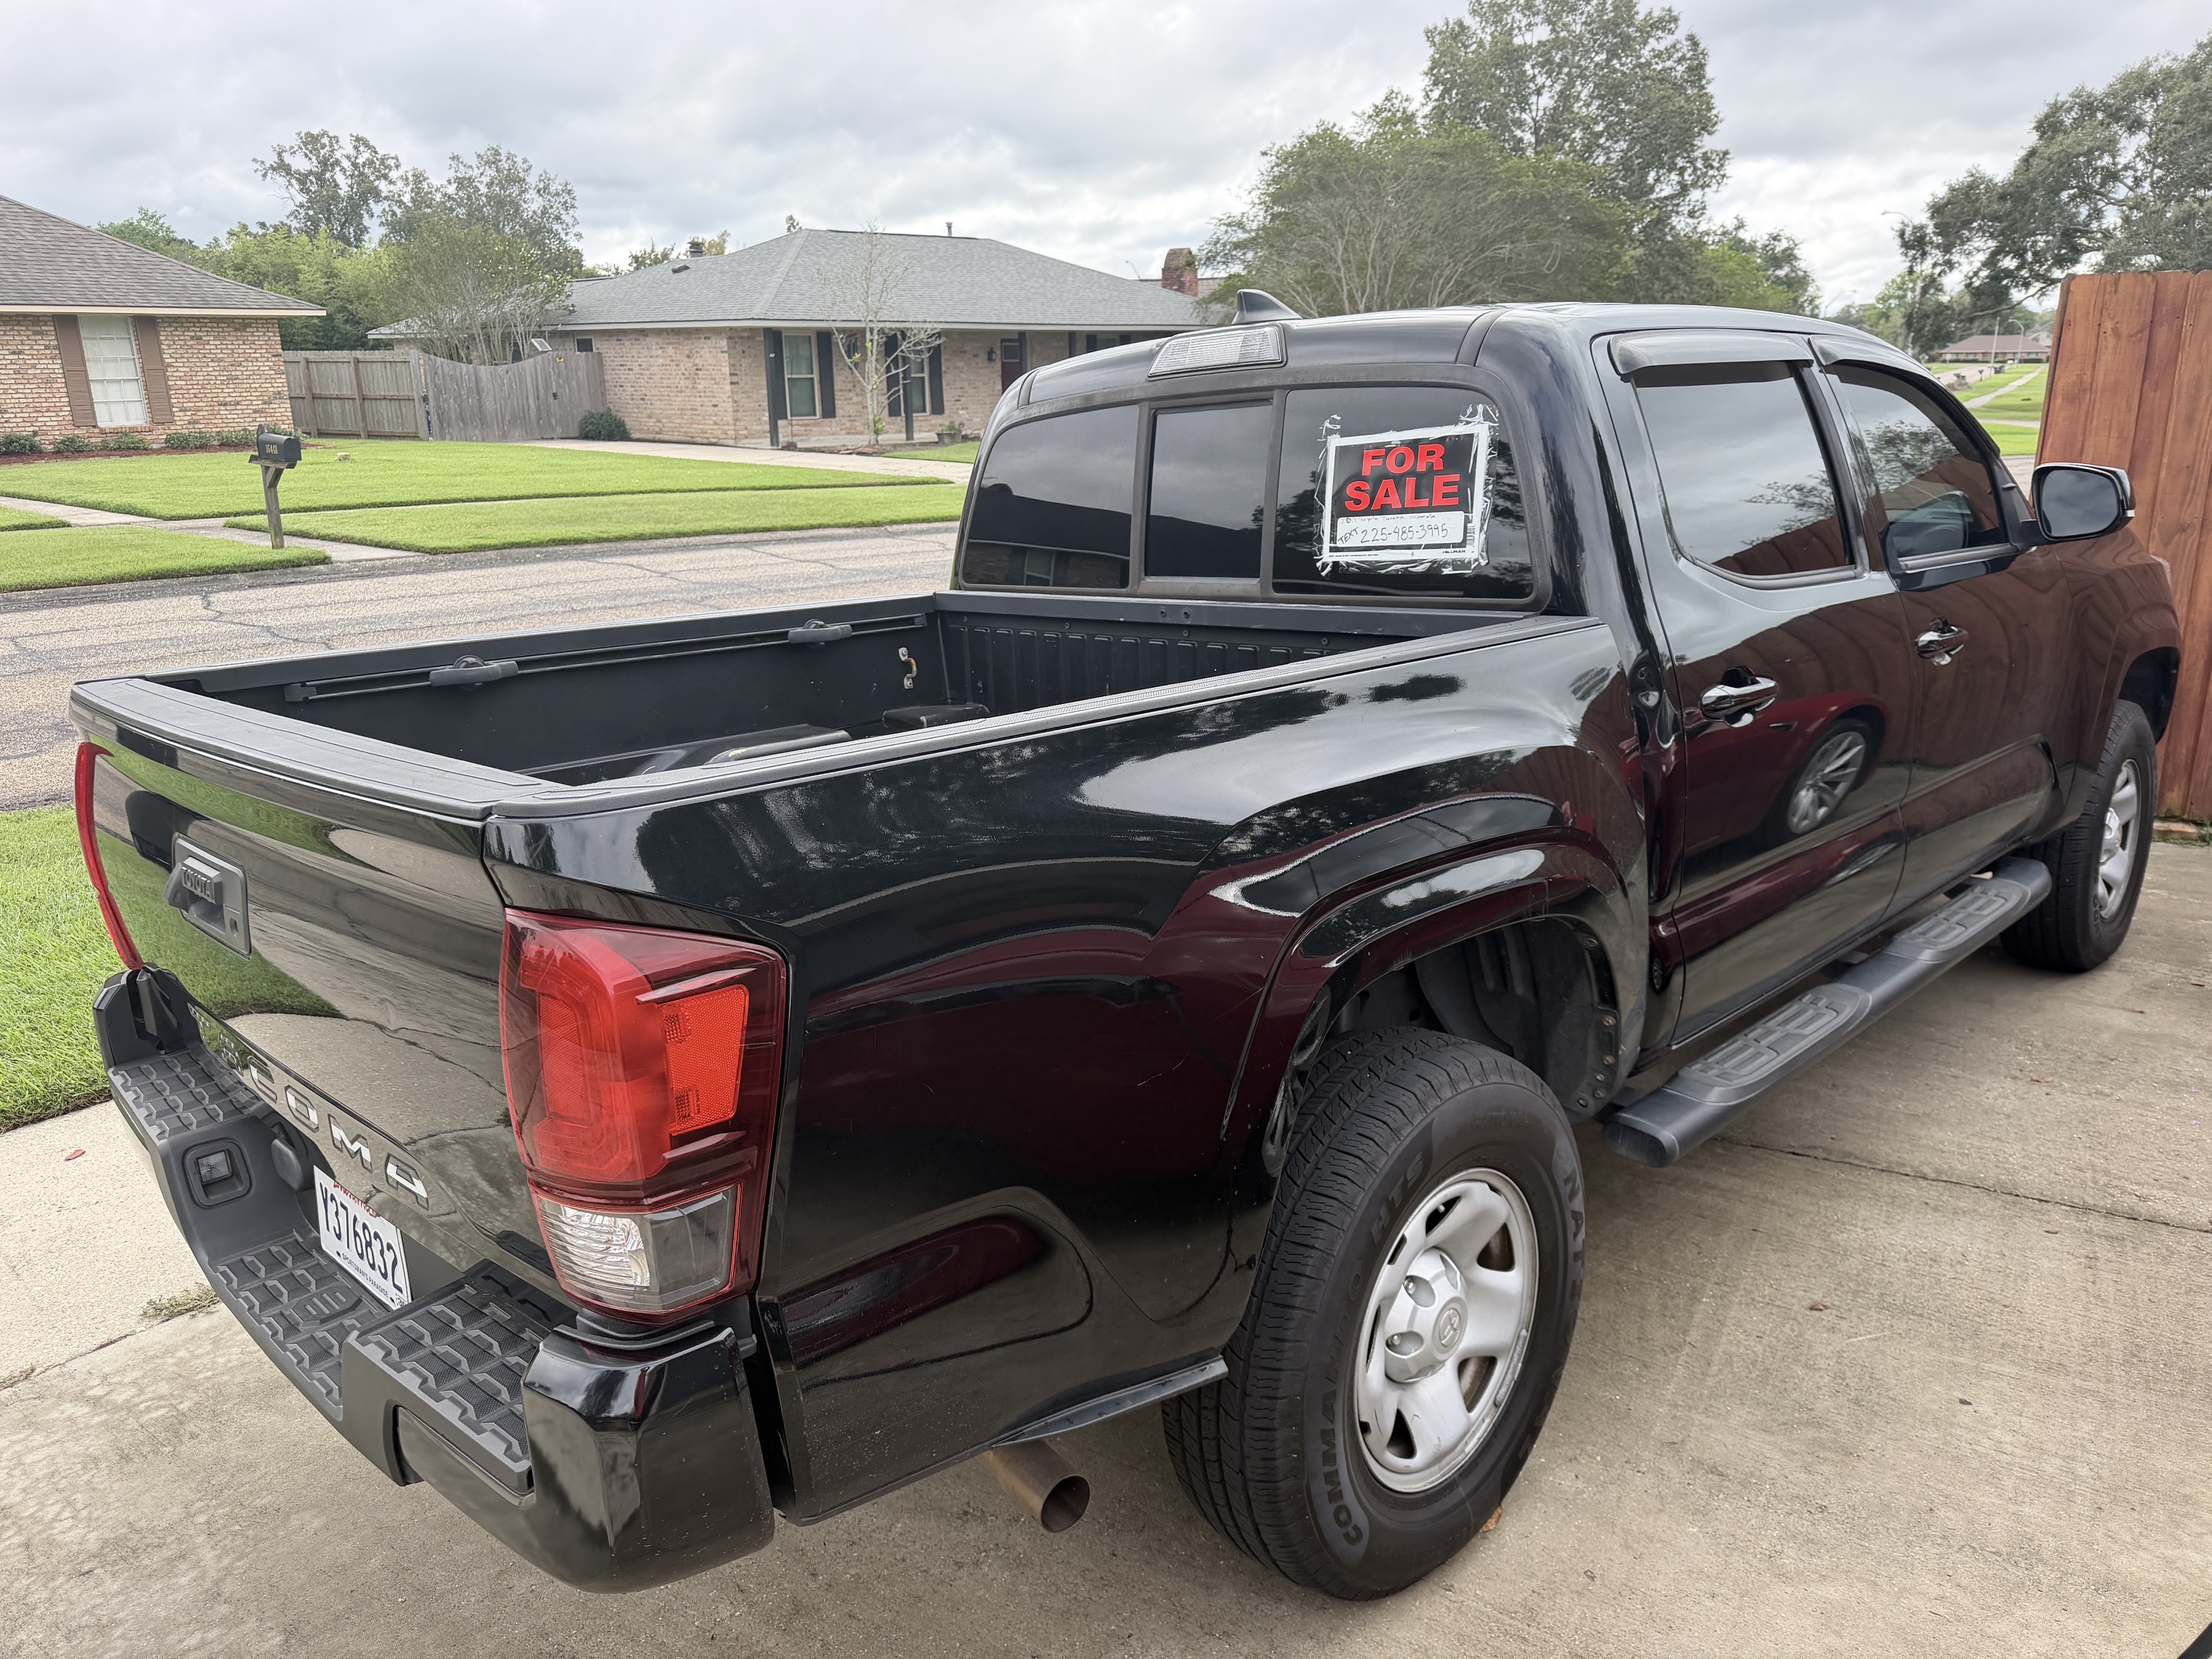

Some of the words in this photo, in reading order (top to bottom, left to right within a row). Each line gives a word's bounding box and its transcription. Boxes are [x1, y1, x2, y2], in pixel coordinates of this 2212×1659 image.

[1362, 443, 1446, 476] FOR
[1345, 474, 1461, 511] SALE
[1338, 526, 1359, 544] TEXT
[1360, 523, 1448, 544] 225-485-3995
[181, 866, 215, 900] TOYOTA
[187, 1002, 430, 1211] TACOMA
[320, 1182, 403, 1294] Y376832
[342, 1252, 369, 1283] SPORTSMAN'S
[369, 1276, 390, 1299] PARADISE
[1320, 1259, 1365, 1547] COMMANDO
[1370, 1152, 1427, 1246] HTS
